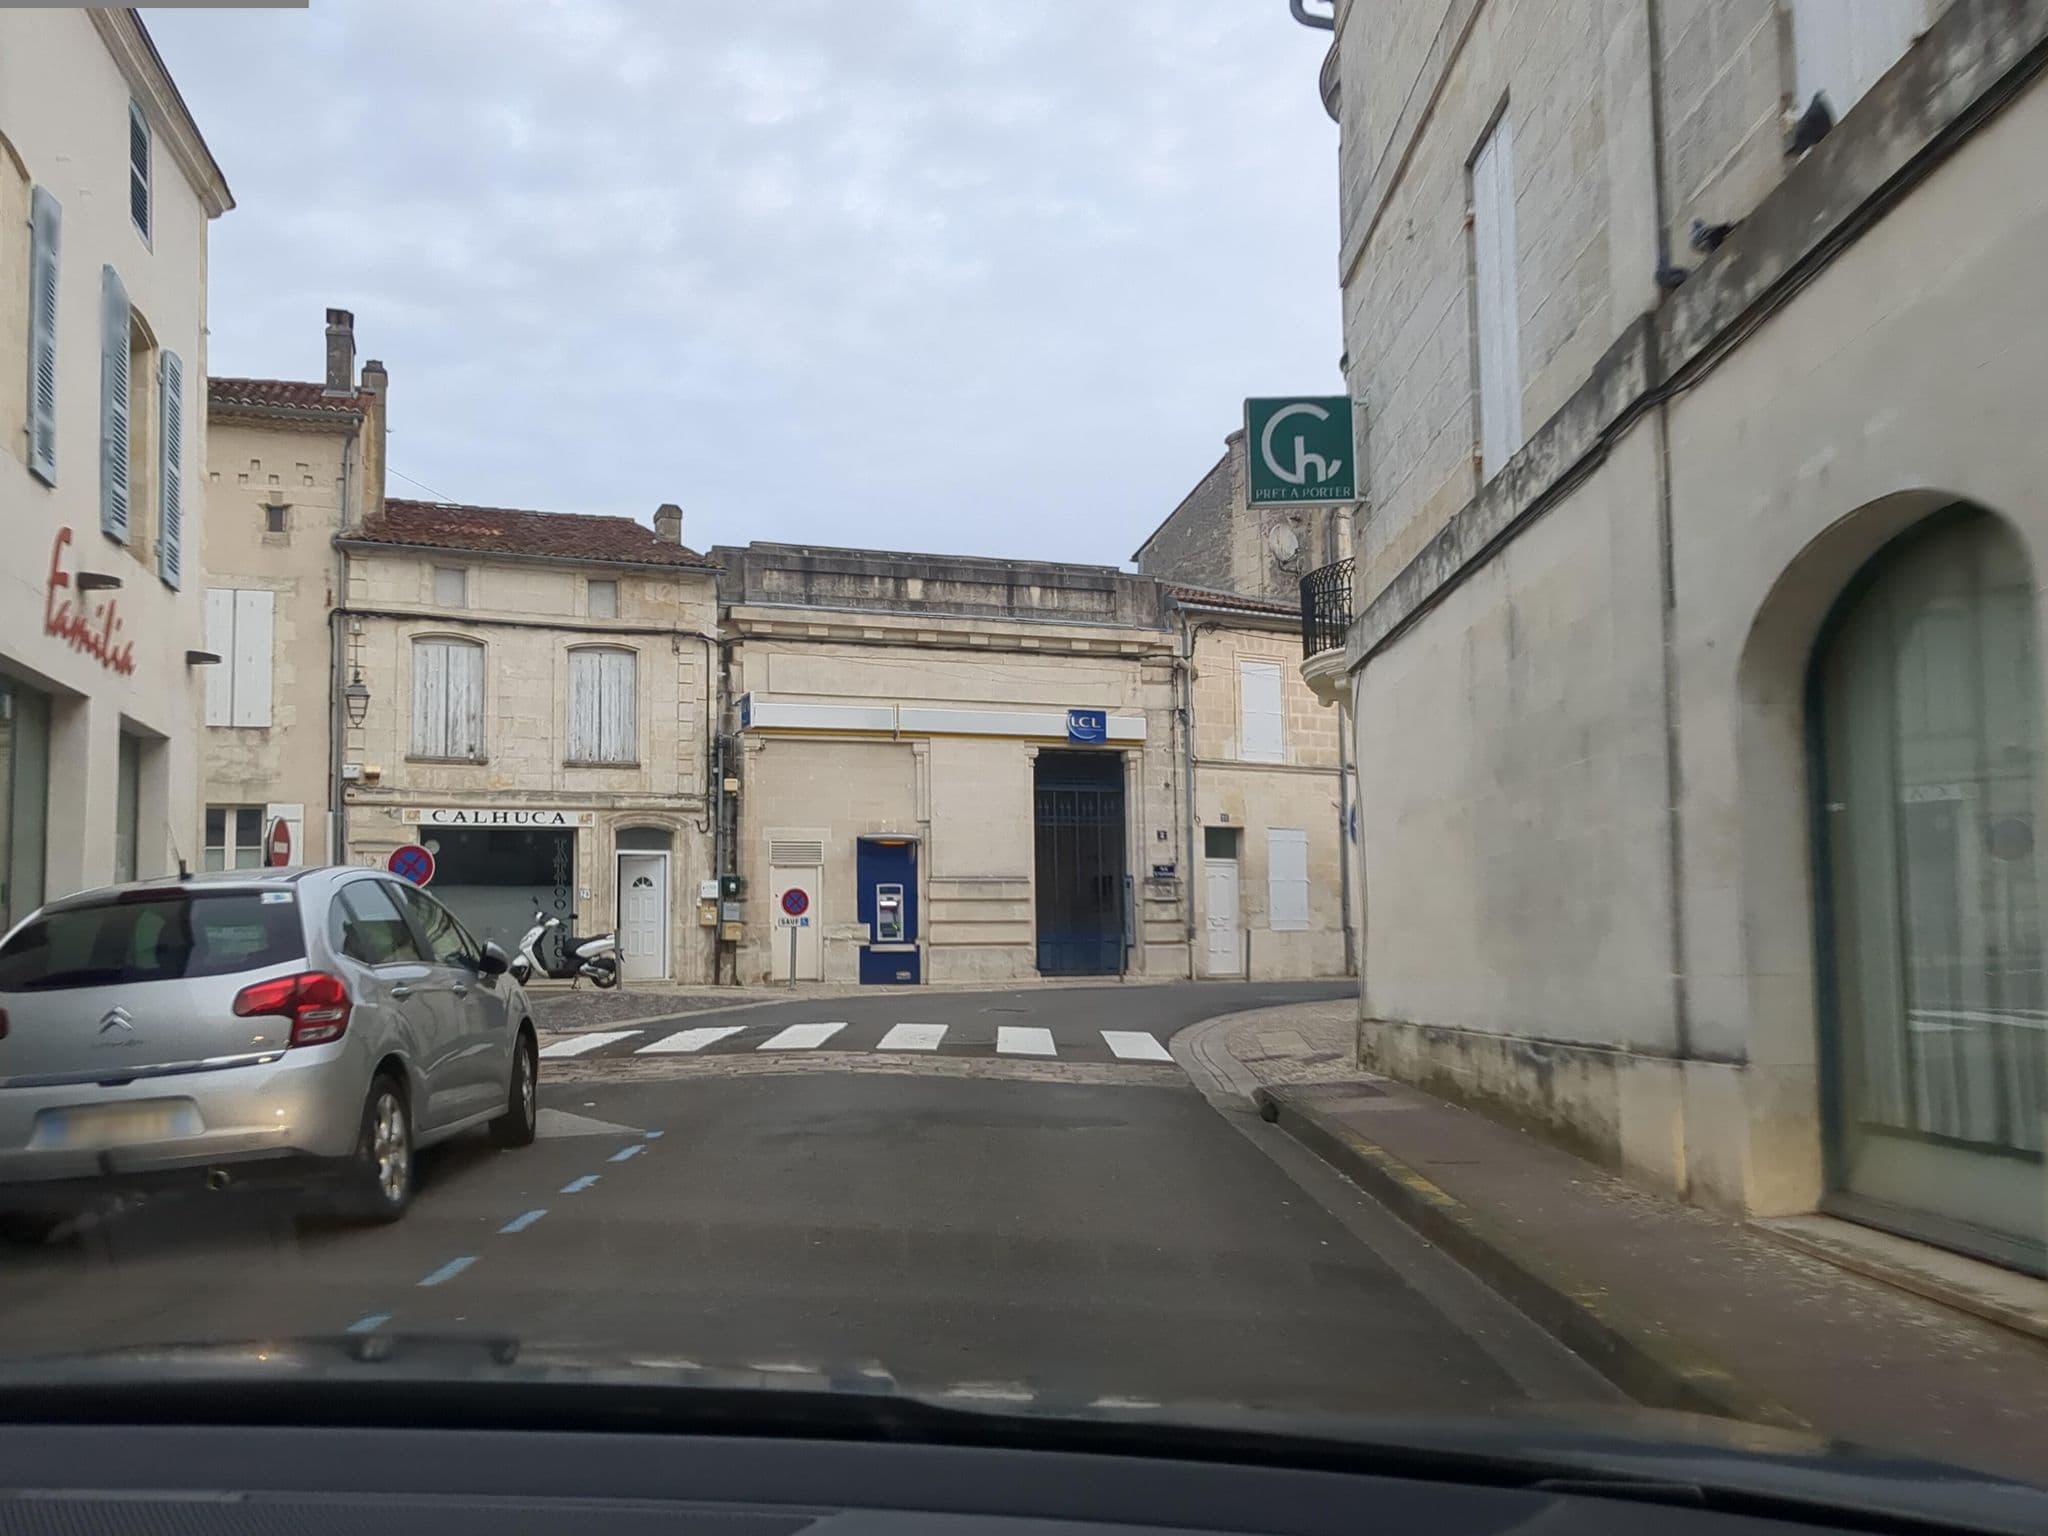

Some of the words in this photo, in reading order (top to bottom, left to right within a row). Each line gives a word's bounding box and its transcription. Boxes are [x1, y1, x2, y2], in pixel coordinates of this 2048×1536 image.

[1289, 487, 1300, 499] A
[1302, 485, 1352, 498] PORTER
[1070, 715, 1102, 729] LCL
[431, 808, 567, 825] CALHUCA
[553, 838, 568, 910] TATTOO
